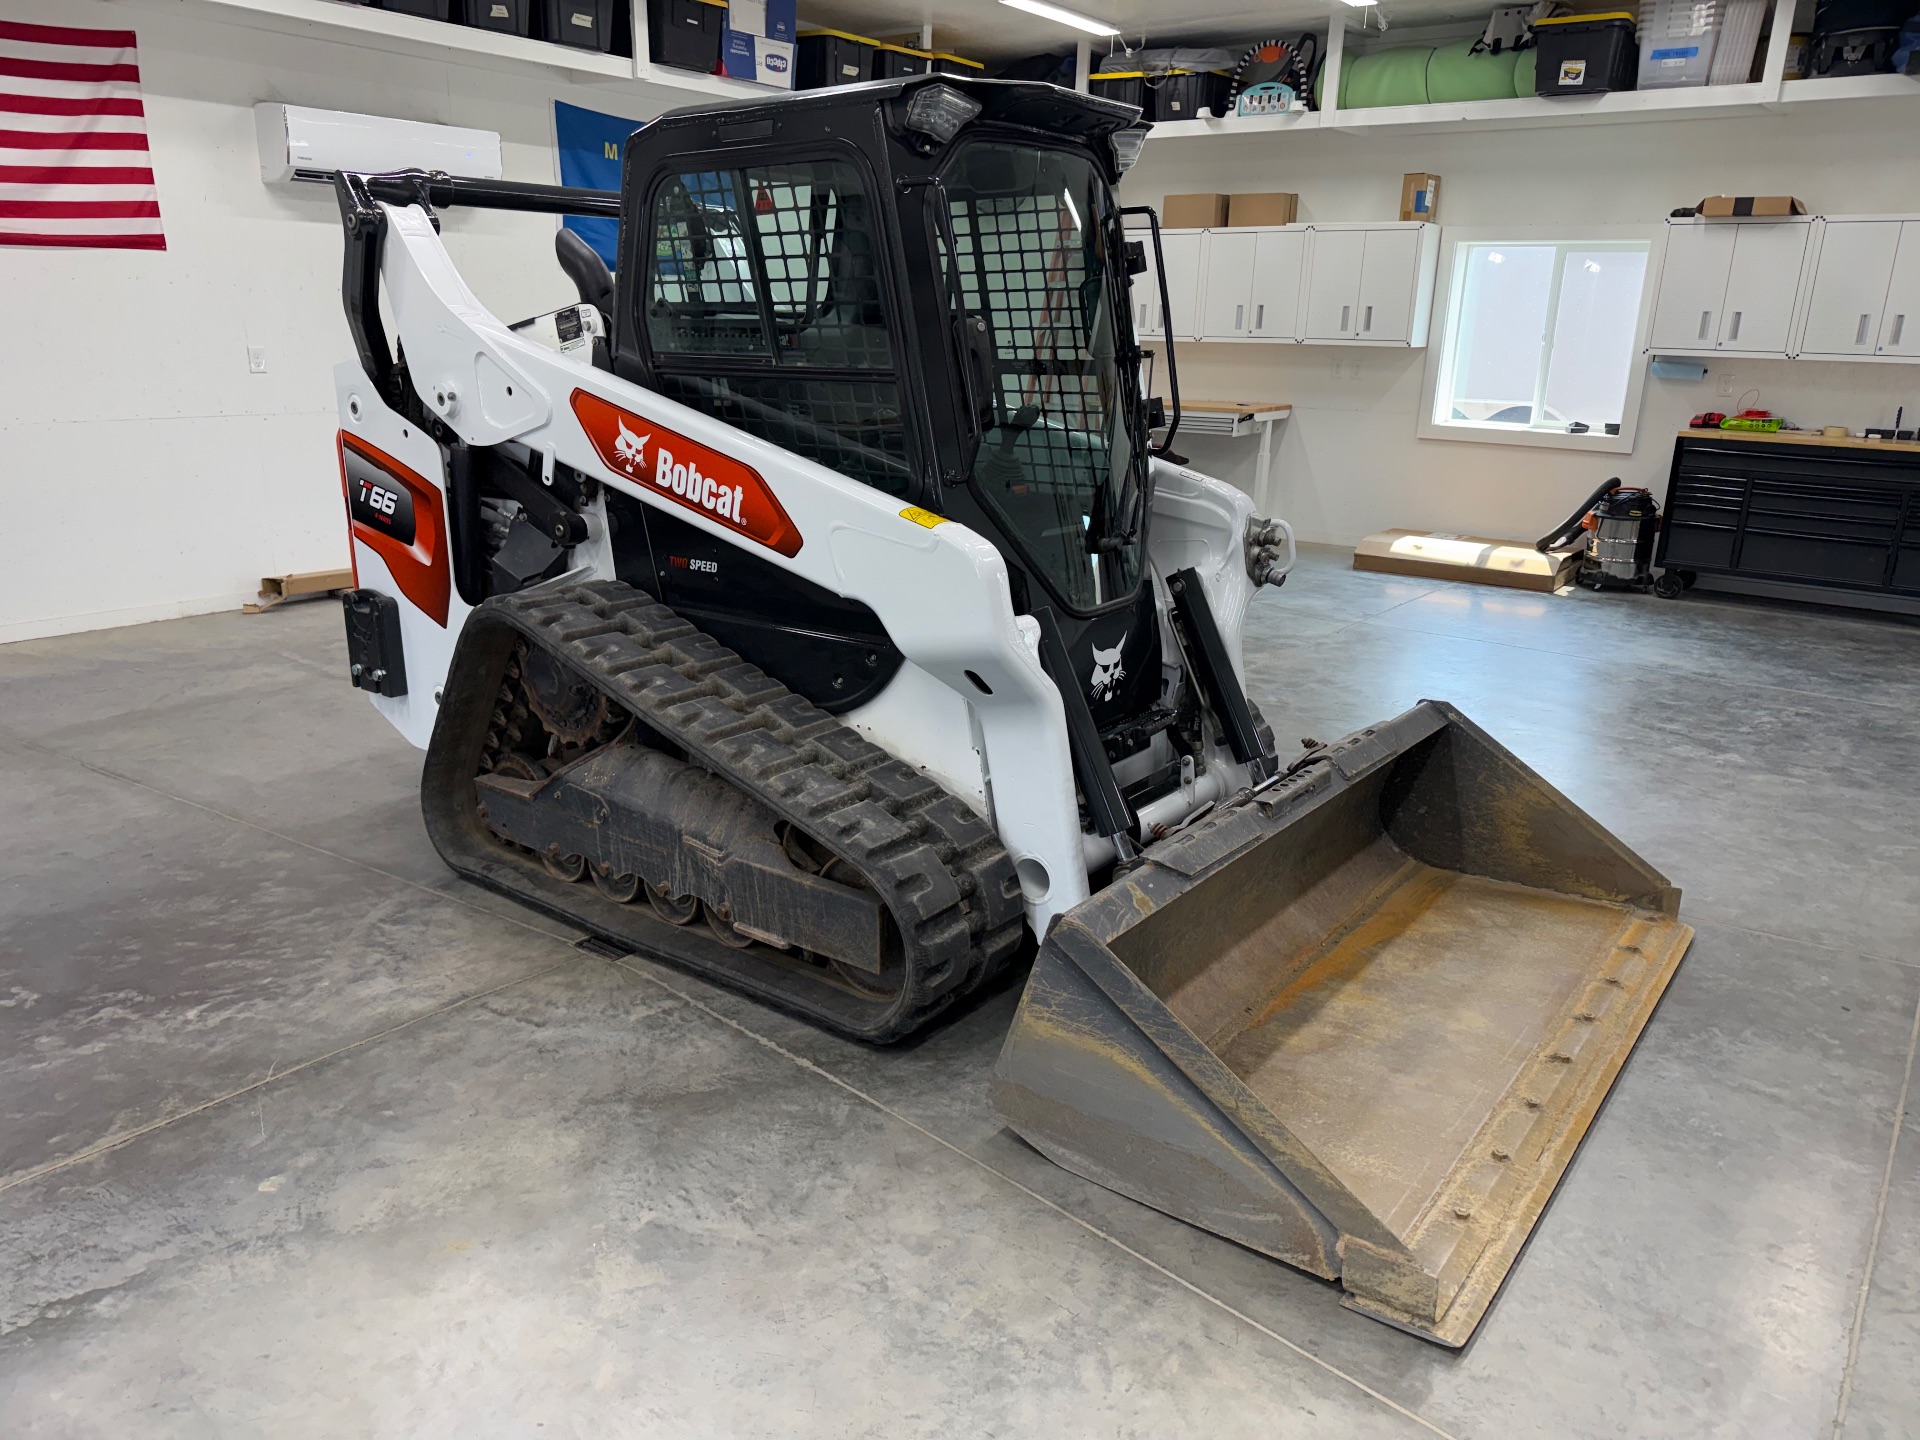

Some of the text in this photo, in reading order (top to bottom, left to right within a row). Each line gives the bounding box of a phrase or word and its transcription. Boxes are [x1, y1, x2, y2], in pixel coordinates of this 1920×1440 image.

[766, 56, 787, 72] chicco
[359, 479, 398, 515] T66
[655, 447, 743, 524] Bobcat
[669, 556, 718, 573] TWO SPEED
